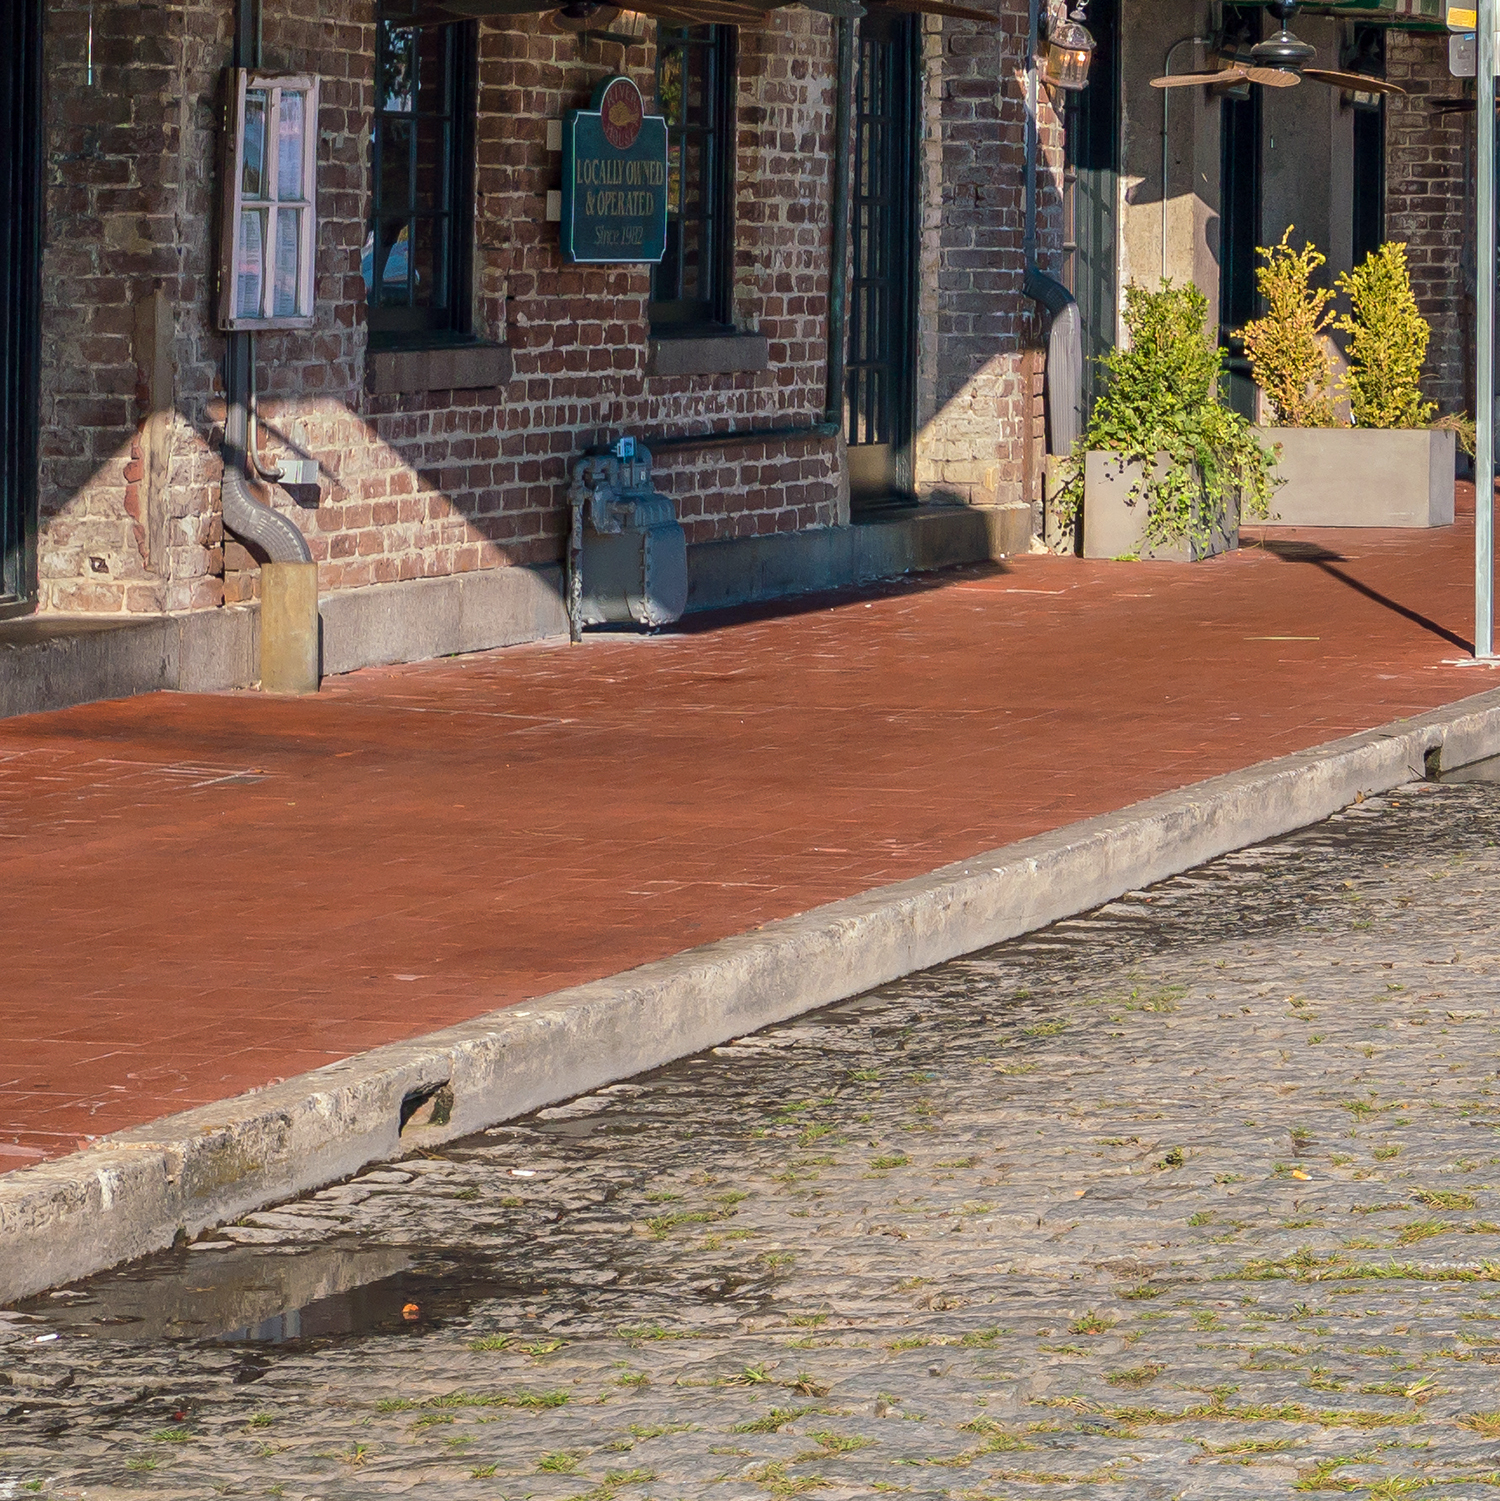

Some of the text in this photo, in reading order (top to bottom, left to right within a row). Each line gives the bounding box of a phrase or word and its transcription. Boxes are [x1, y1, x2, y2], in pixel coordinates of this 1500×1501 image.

[576, 159, 664, 186] LOCALLY OWNED
[585, 190, 654, 216] & OPERATED
[594, 225, 644, 245] Since 1982
